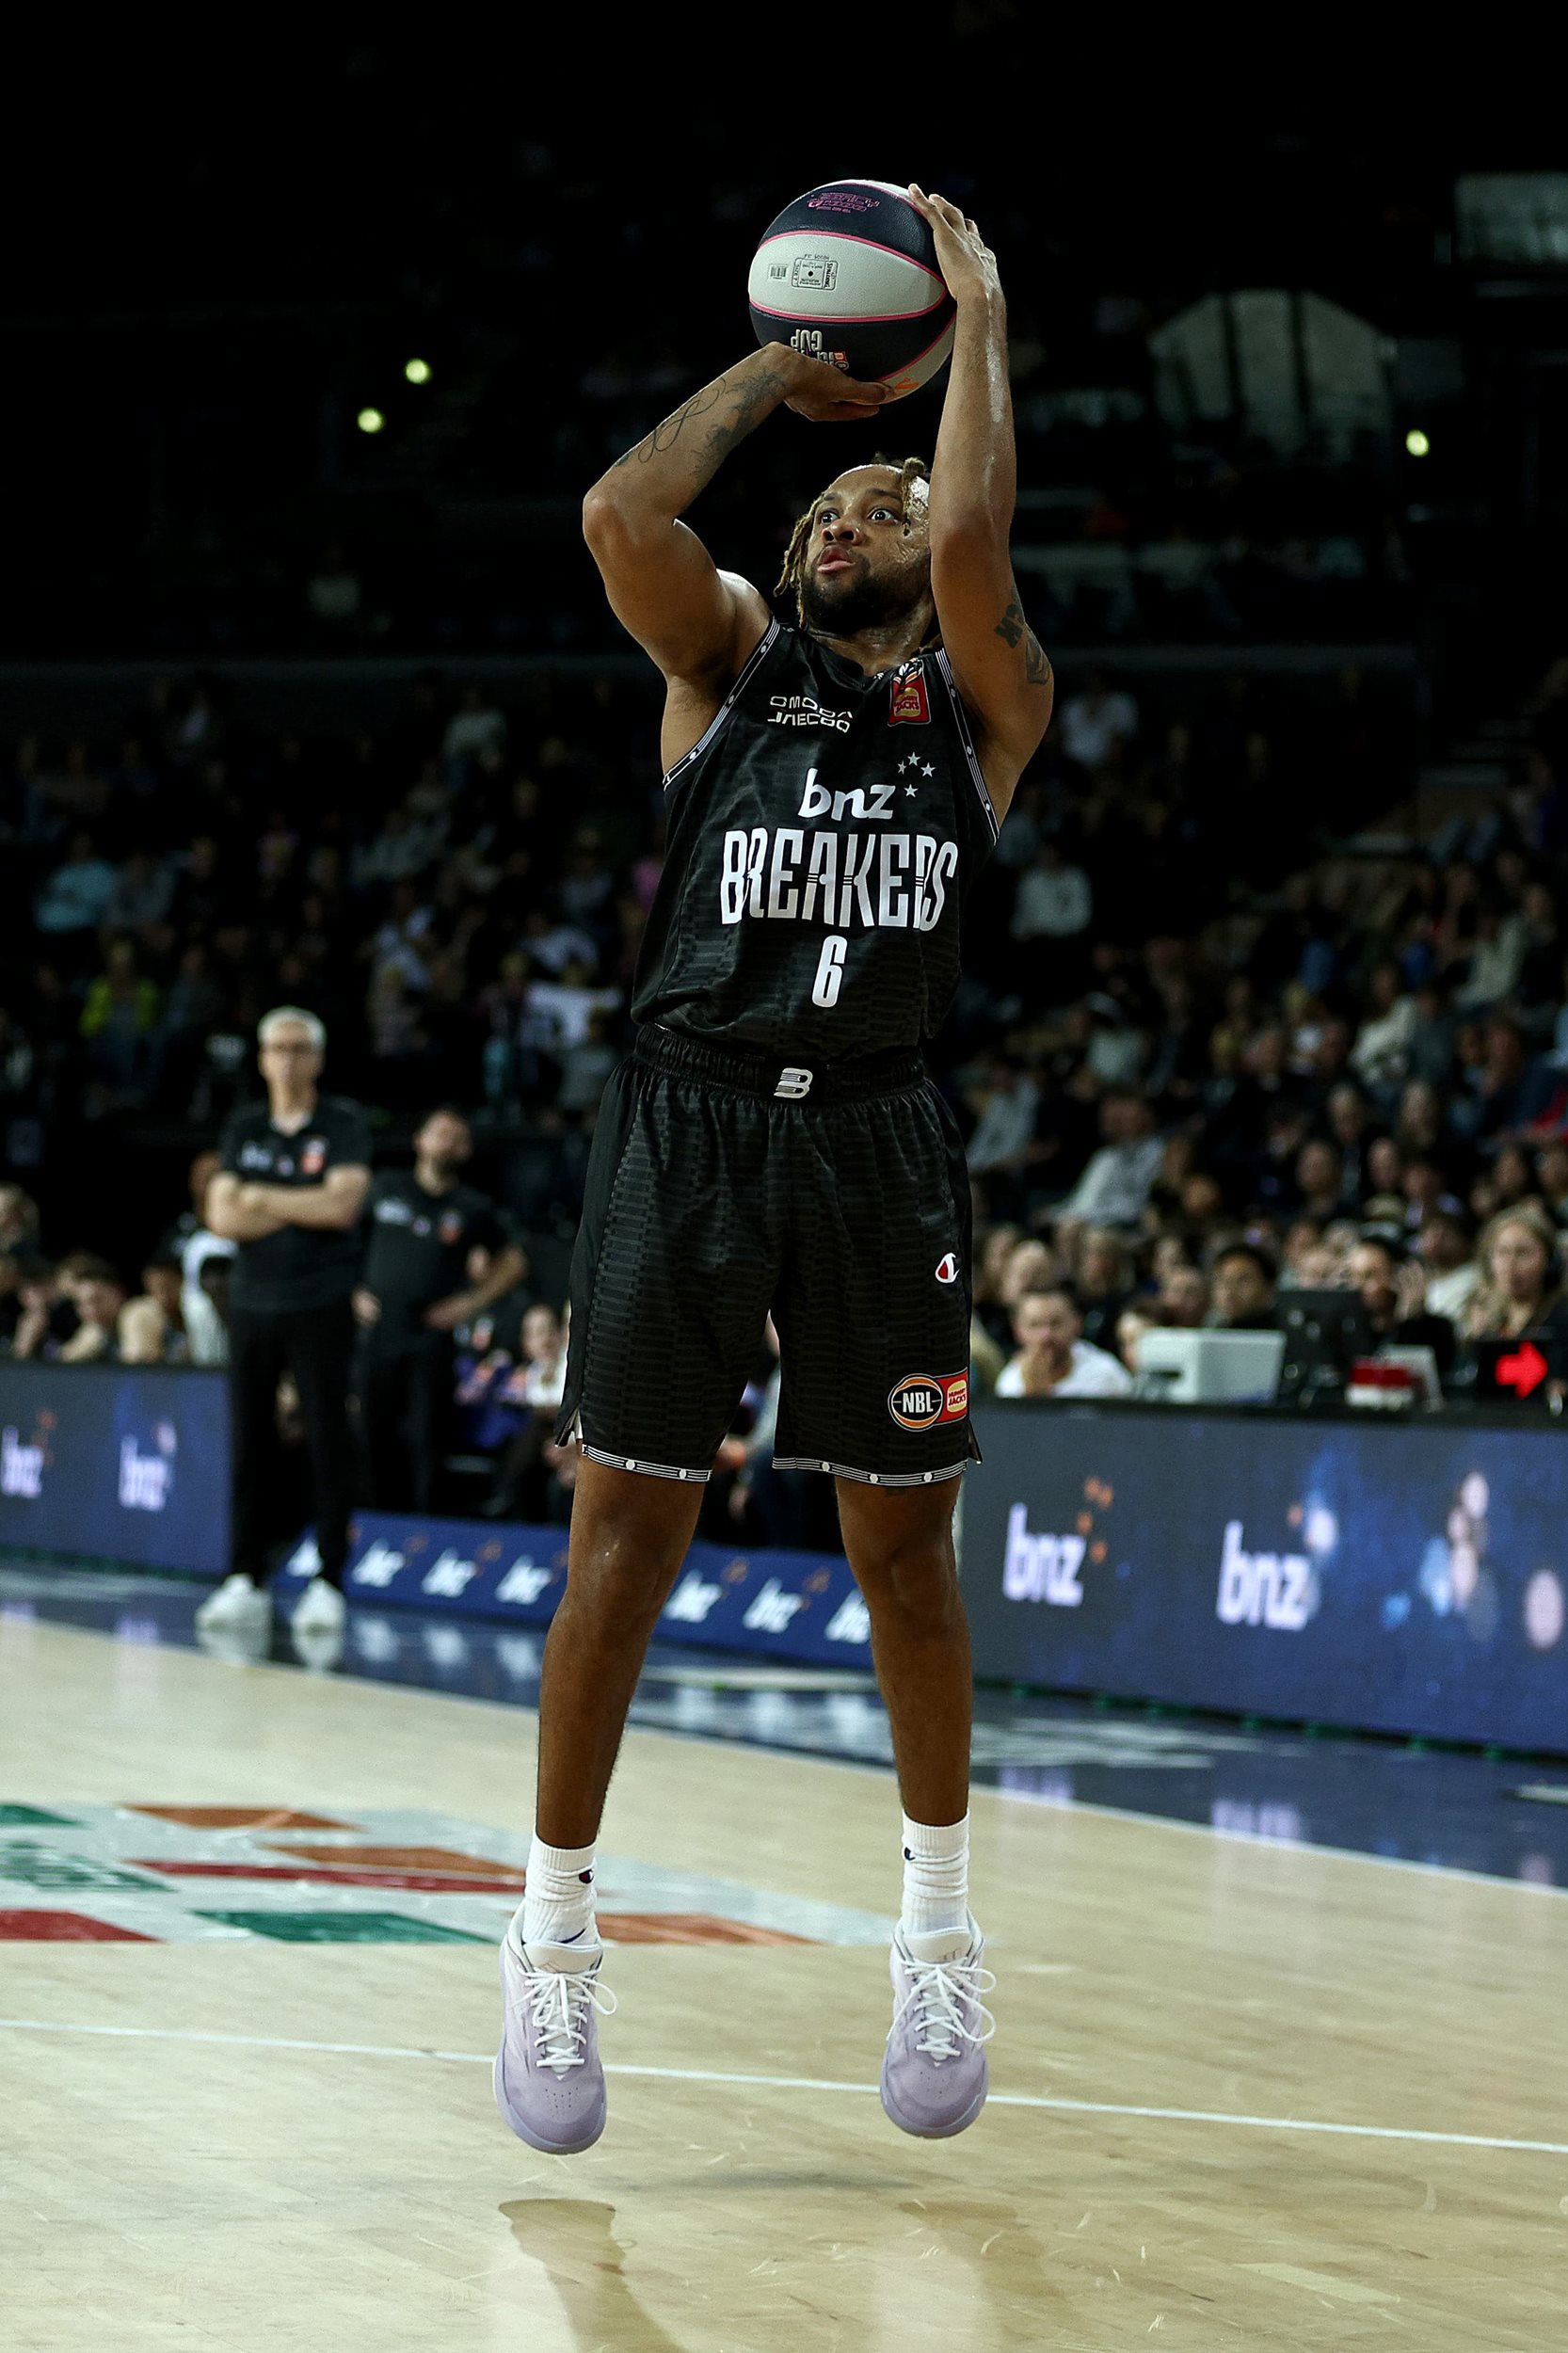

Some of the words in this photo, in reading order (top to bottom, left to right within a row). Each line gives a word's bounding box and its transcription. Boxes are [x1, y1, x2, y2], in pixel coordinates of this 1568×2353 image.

[769, 696, 853, 719] OMODA
[798, 768, 895, 821] bnz
[811, 935, 847, 1008] 6
[902, 1391, 934, 1413] NBL
[1002, 1503, 1087, 1607] bnz
[1216, 1520, 1311, 1631] bnz
